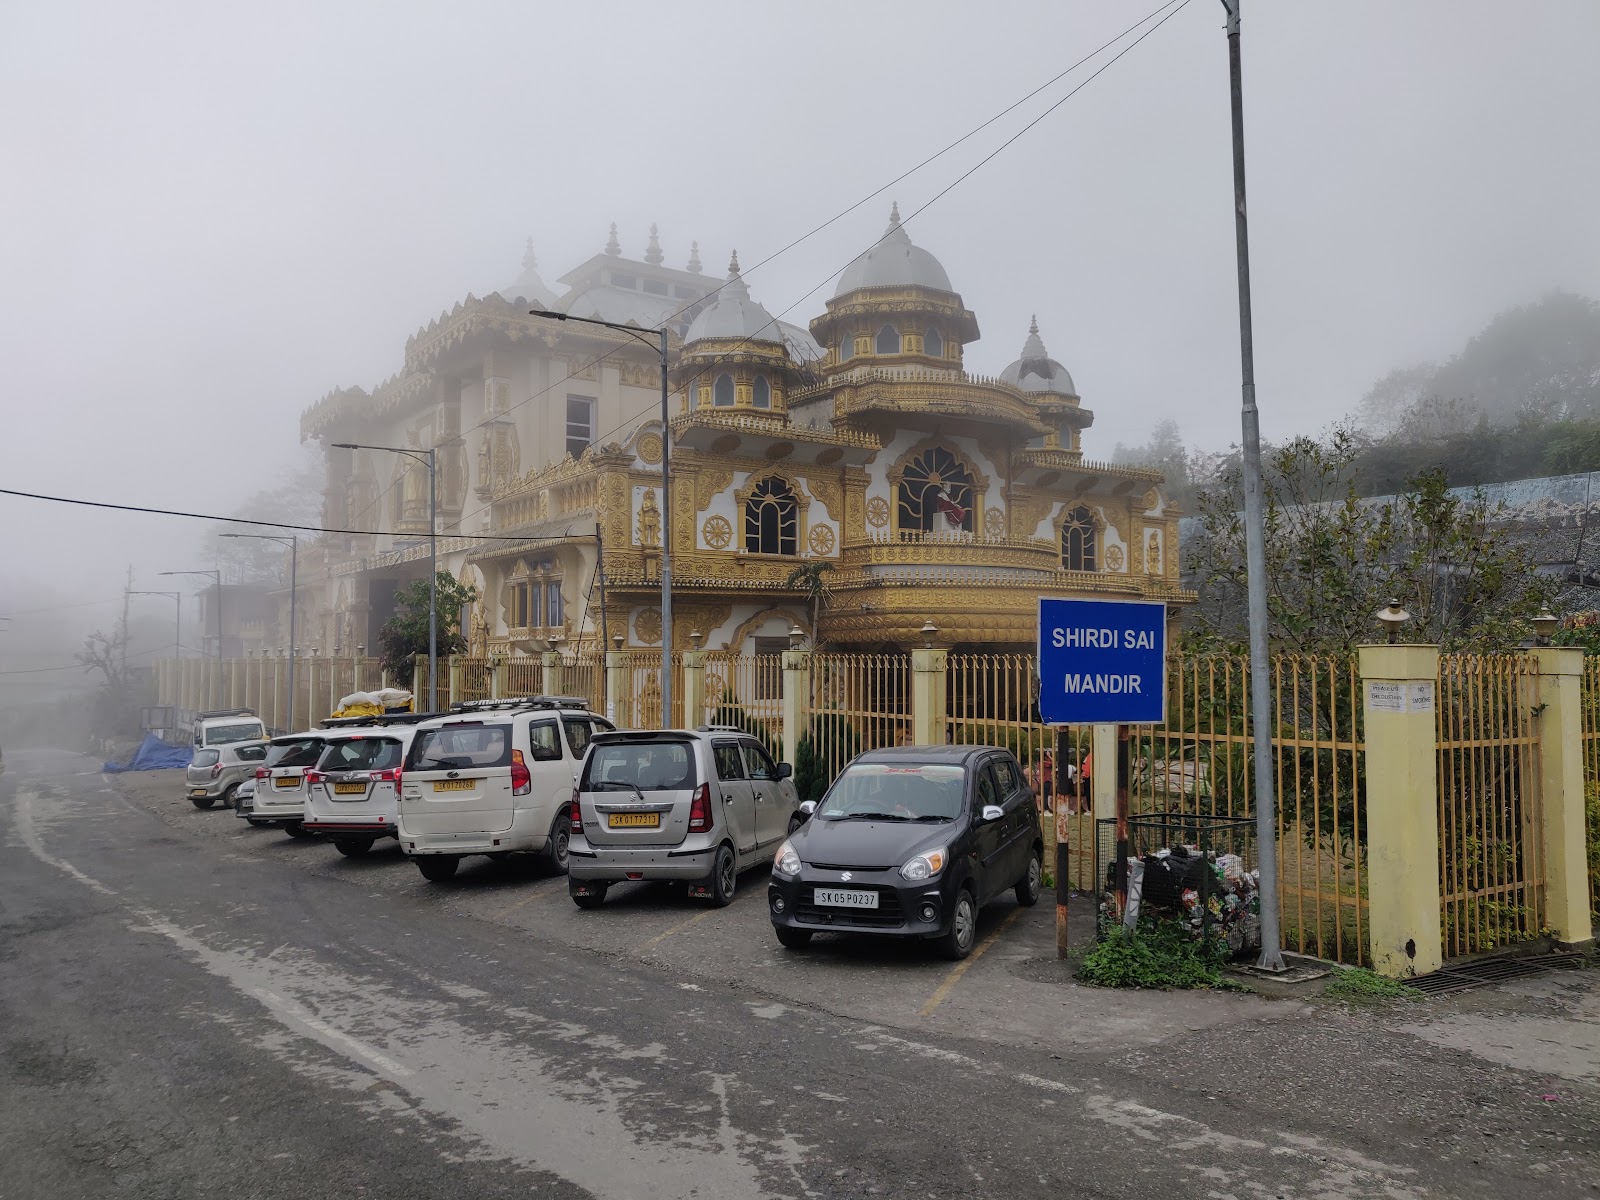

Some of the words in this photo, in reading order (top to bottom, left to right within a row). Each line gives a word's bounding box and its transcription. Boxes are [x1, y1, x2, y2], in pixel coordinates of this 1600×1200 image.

[1052, 627, 1118, 649] SHIRDI
[1123, 629, 1154, 650] SAI
[1064, 673, 1141, 694] MANDIR
